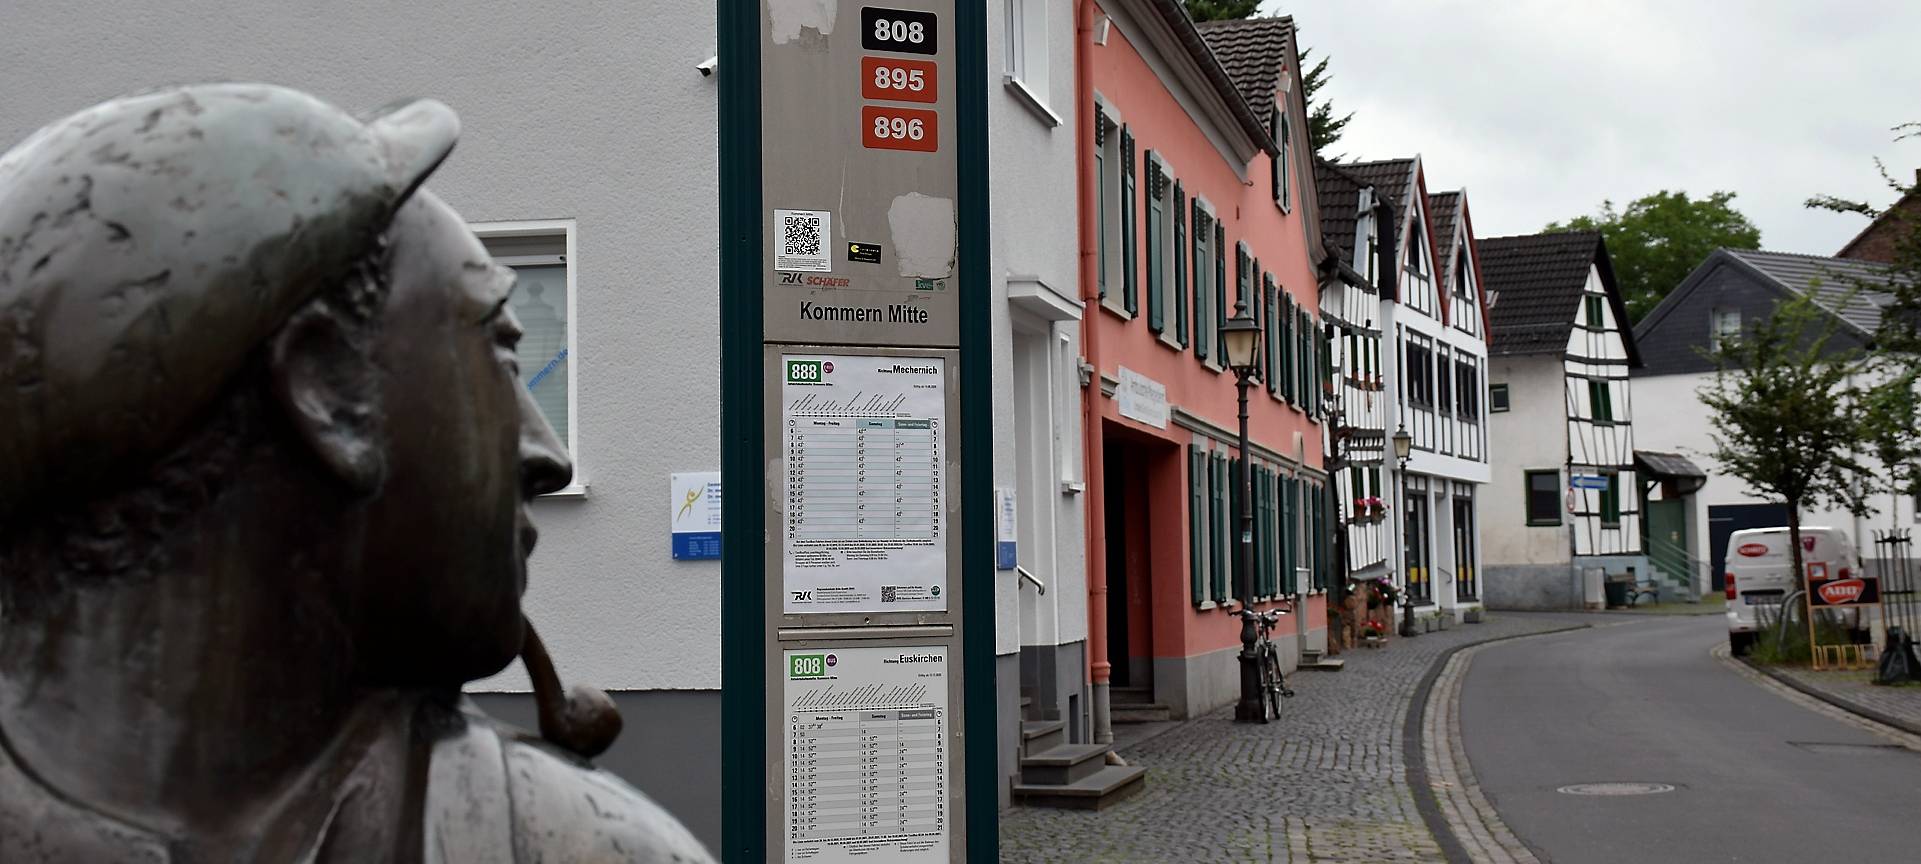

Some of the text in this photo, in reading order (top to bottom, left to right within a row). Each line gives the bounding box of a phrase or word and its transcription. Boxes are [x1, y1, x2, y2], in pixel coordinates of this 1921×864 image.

[874, 19, 924, 43] 808
[874, 66, 925, 91] 895
[874, 116, 924, 141] 896
[800, 301, 928, 324] Kommern Mitte
[792, 364, 816, 379] 888
[893, 365, 938, 375] Mechernich
[795, 658, 820, 674] 808
[900, 654, 943, 663] Euskirchen
